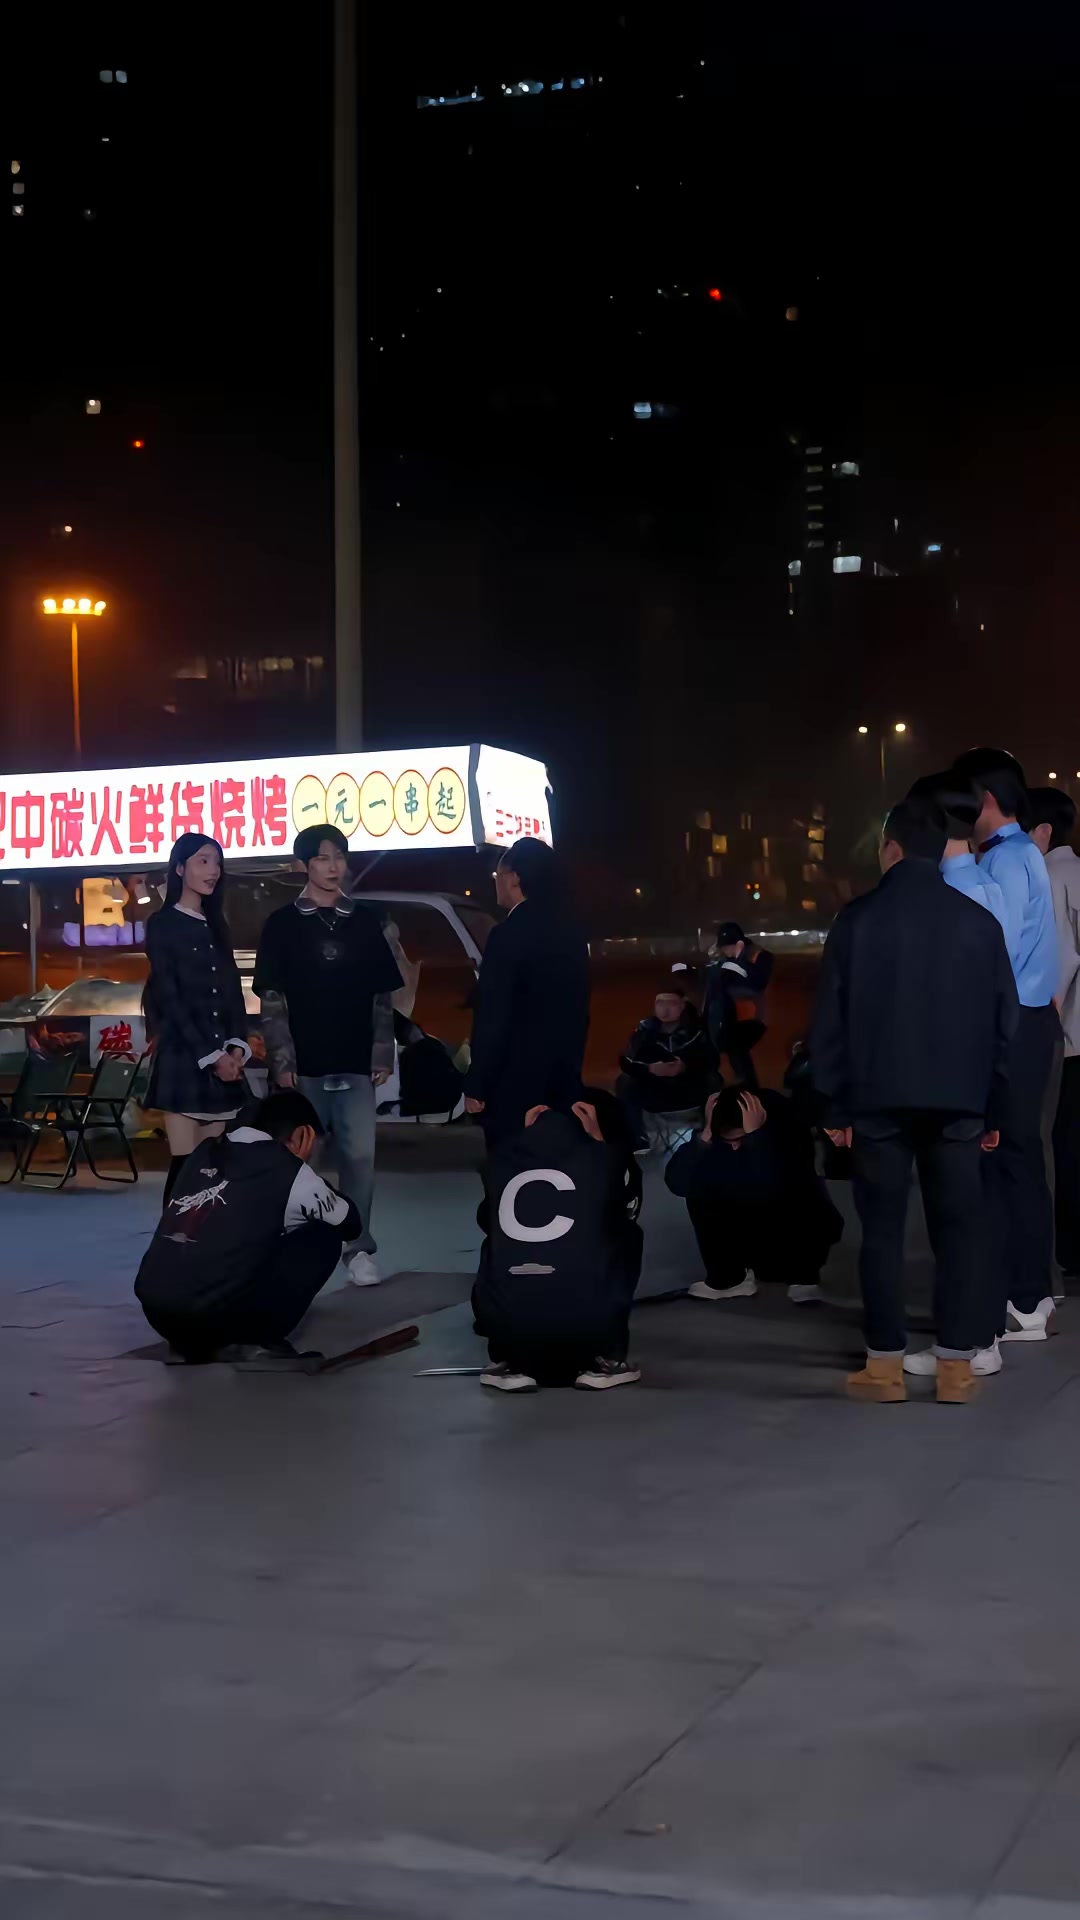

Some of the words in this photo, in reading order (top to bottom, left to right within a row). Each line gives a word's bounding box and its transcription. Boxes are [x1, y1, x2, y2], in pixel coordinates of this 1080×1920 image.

[0, 774, 287, 859] 中碳火鲜货烧烤
[302, 782, 457, 824] 一元一串起
[498, 1168, 576, 1243] C
